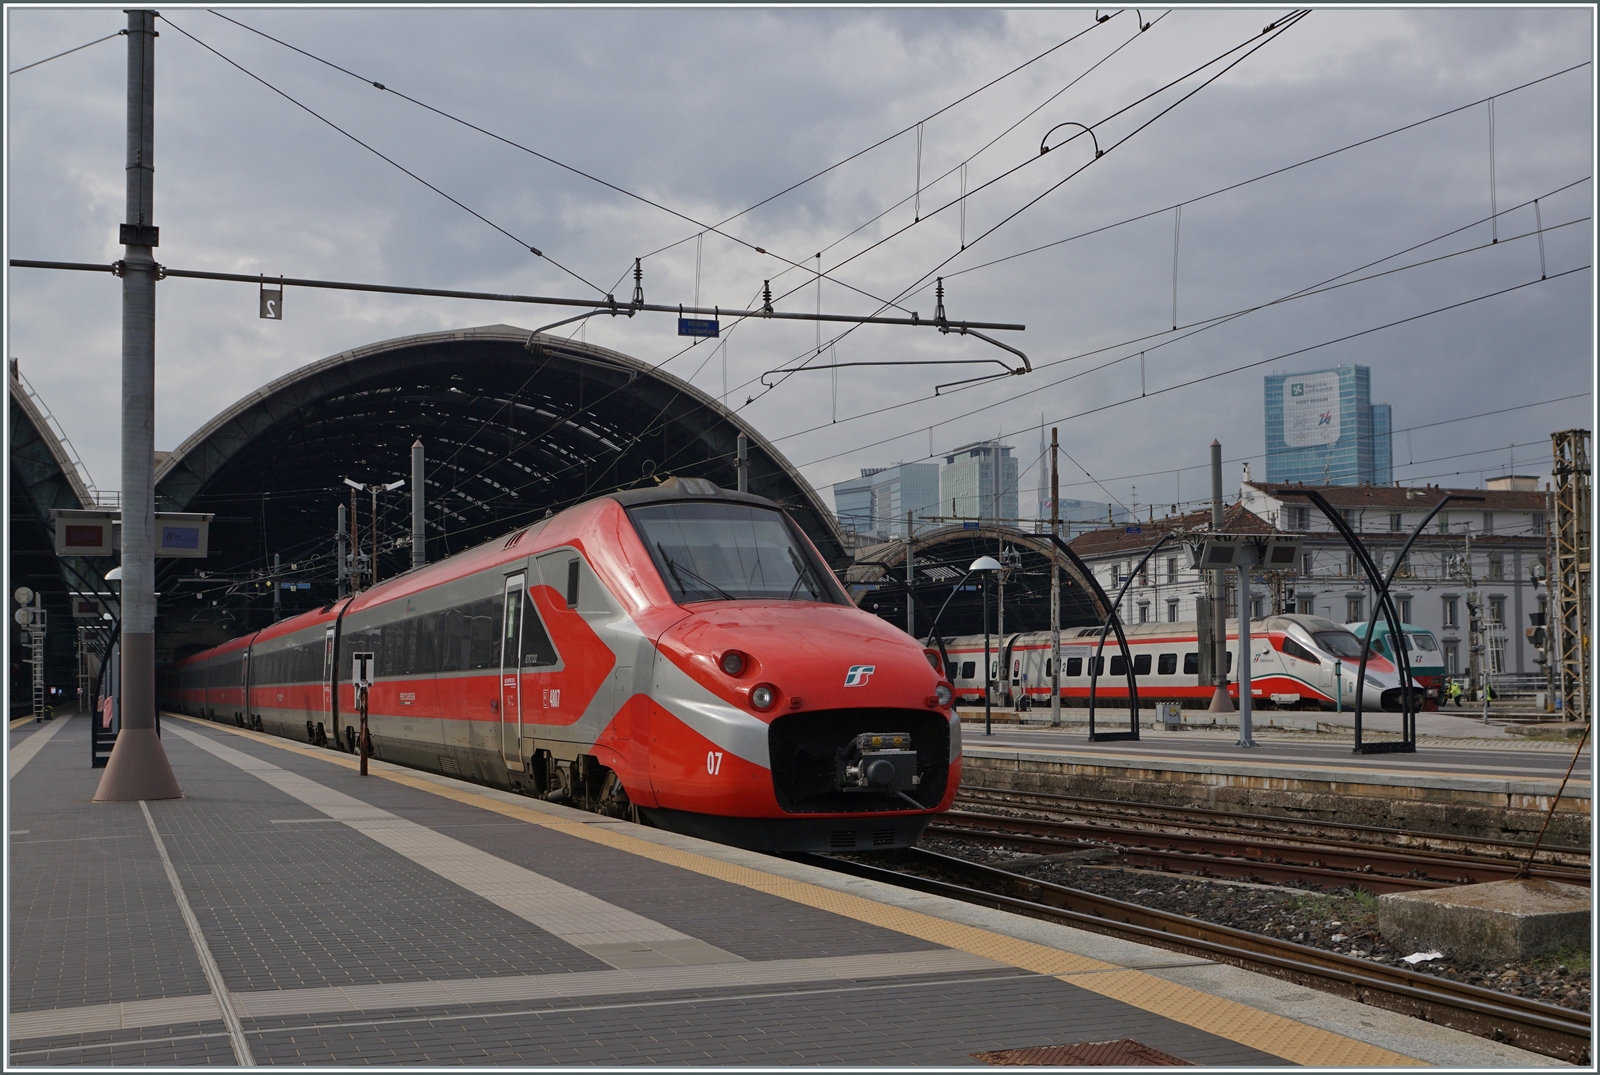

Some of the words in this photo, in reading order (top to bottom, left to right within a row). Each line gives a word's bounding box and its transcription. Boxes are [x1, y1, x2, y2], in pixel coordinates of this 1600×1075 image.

[1305, 382, 1327, 390] Regione
[1305, 386, 1333, 394] Lombardia
[707, 750, 723, 776] 07
